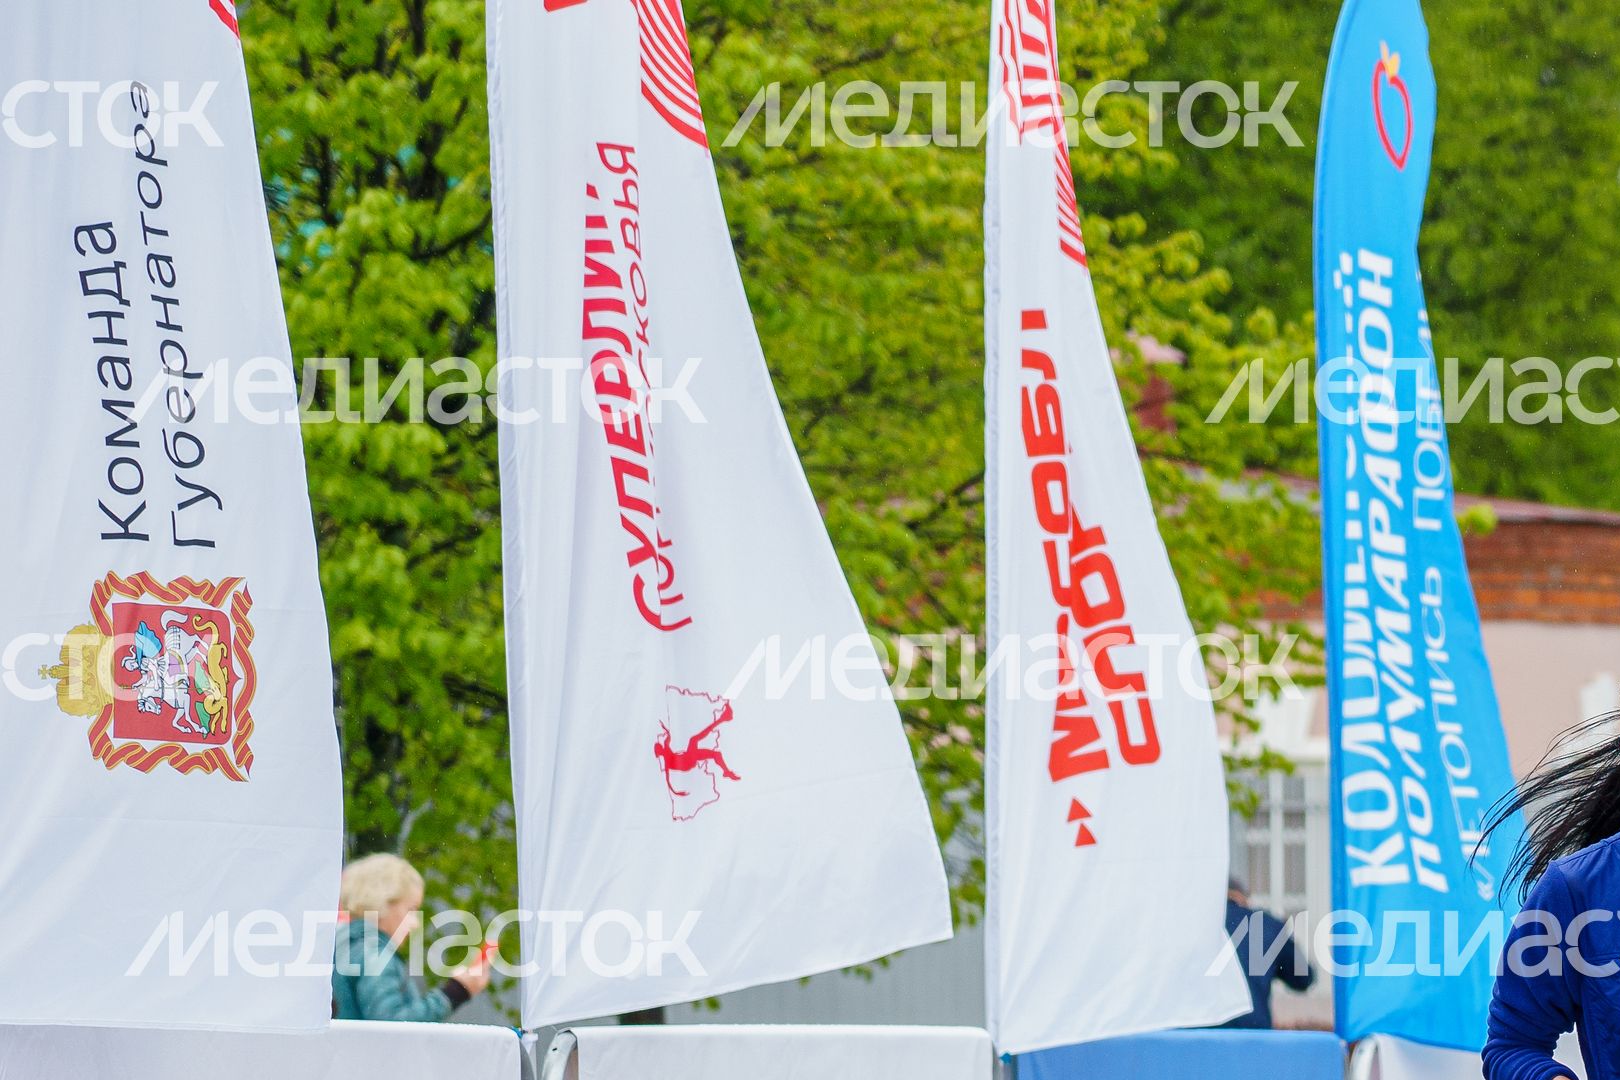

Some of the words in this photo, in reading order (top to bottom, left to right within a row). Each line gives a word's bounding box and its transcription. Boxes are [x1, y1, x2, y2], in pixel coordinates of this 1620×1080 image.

[74, 220, 150, 541] Команда
[130, 81, 223, 548] Губернатора
[1358, 247, 1448, 892] ПОЛУМАРАФОН
